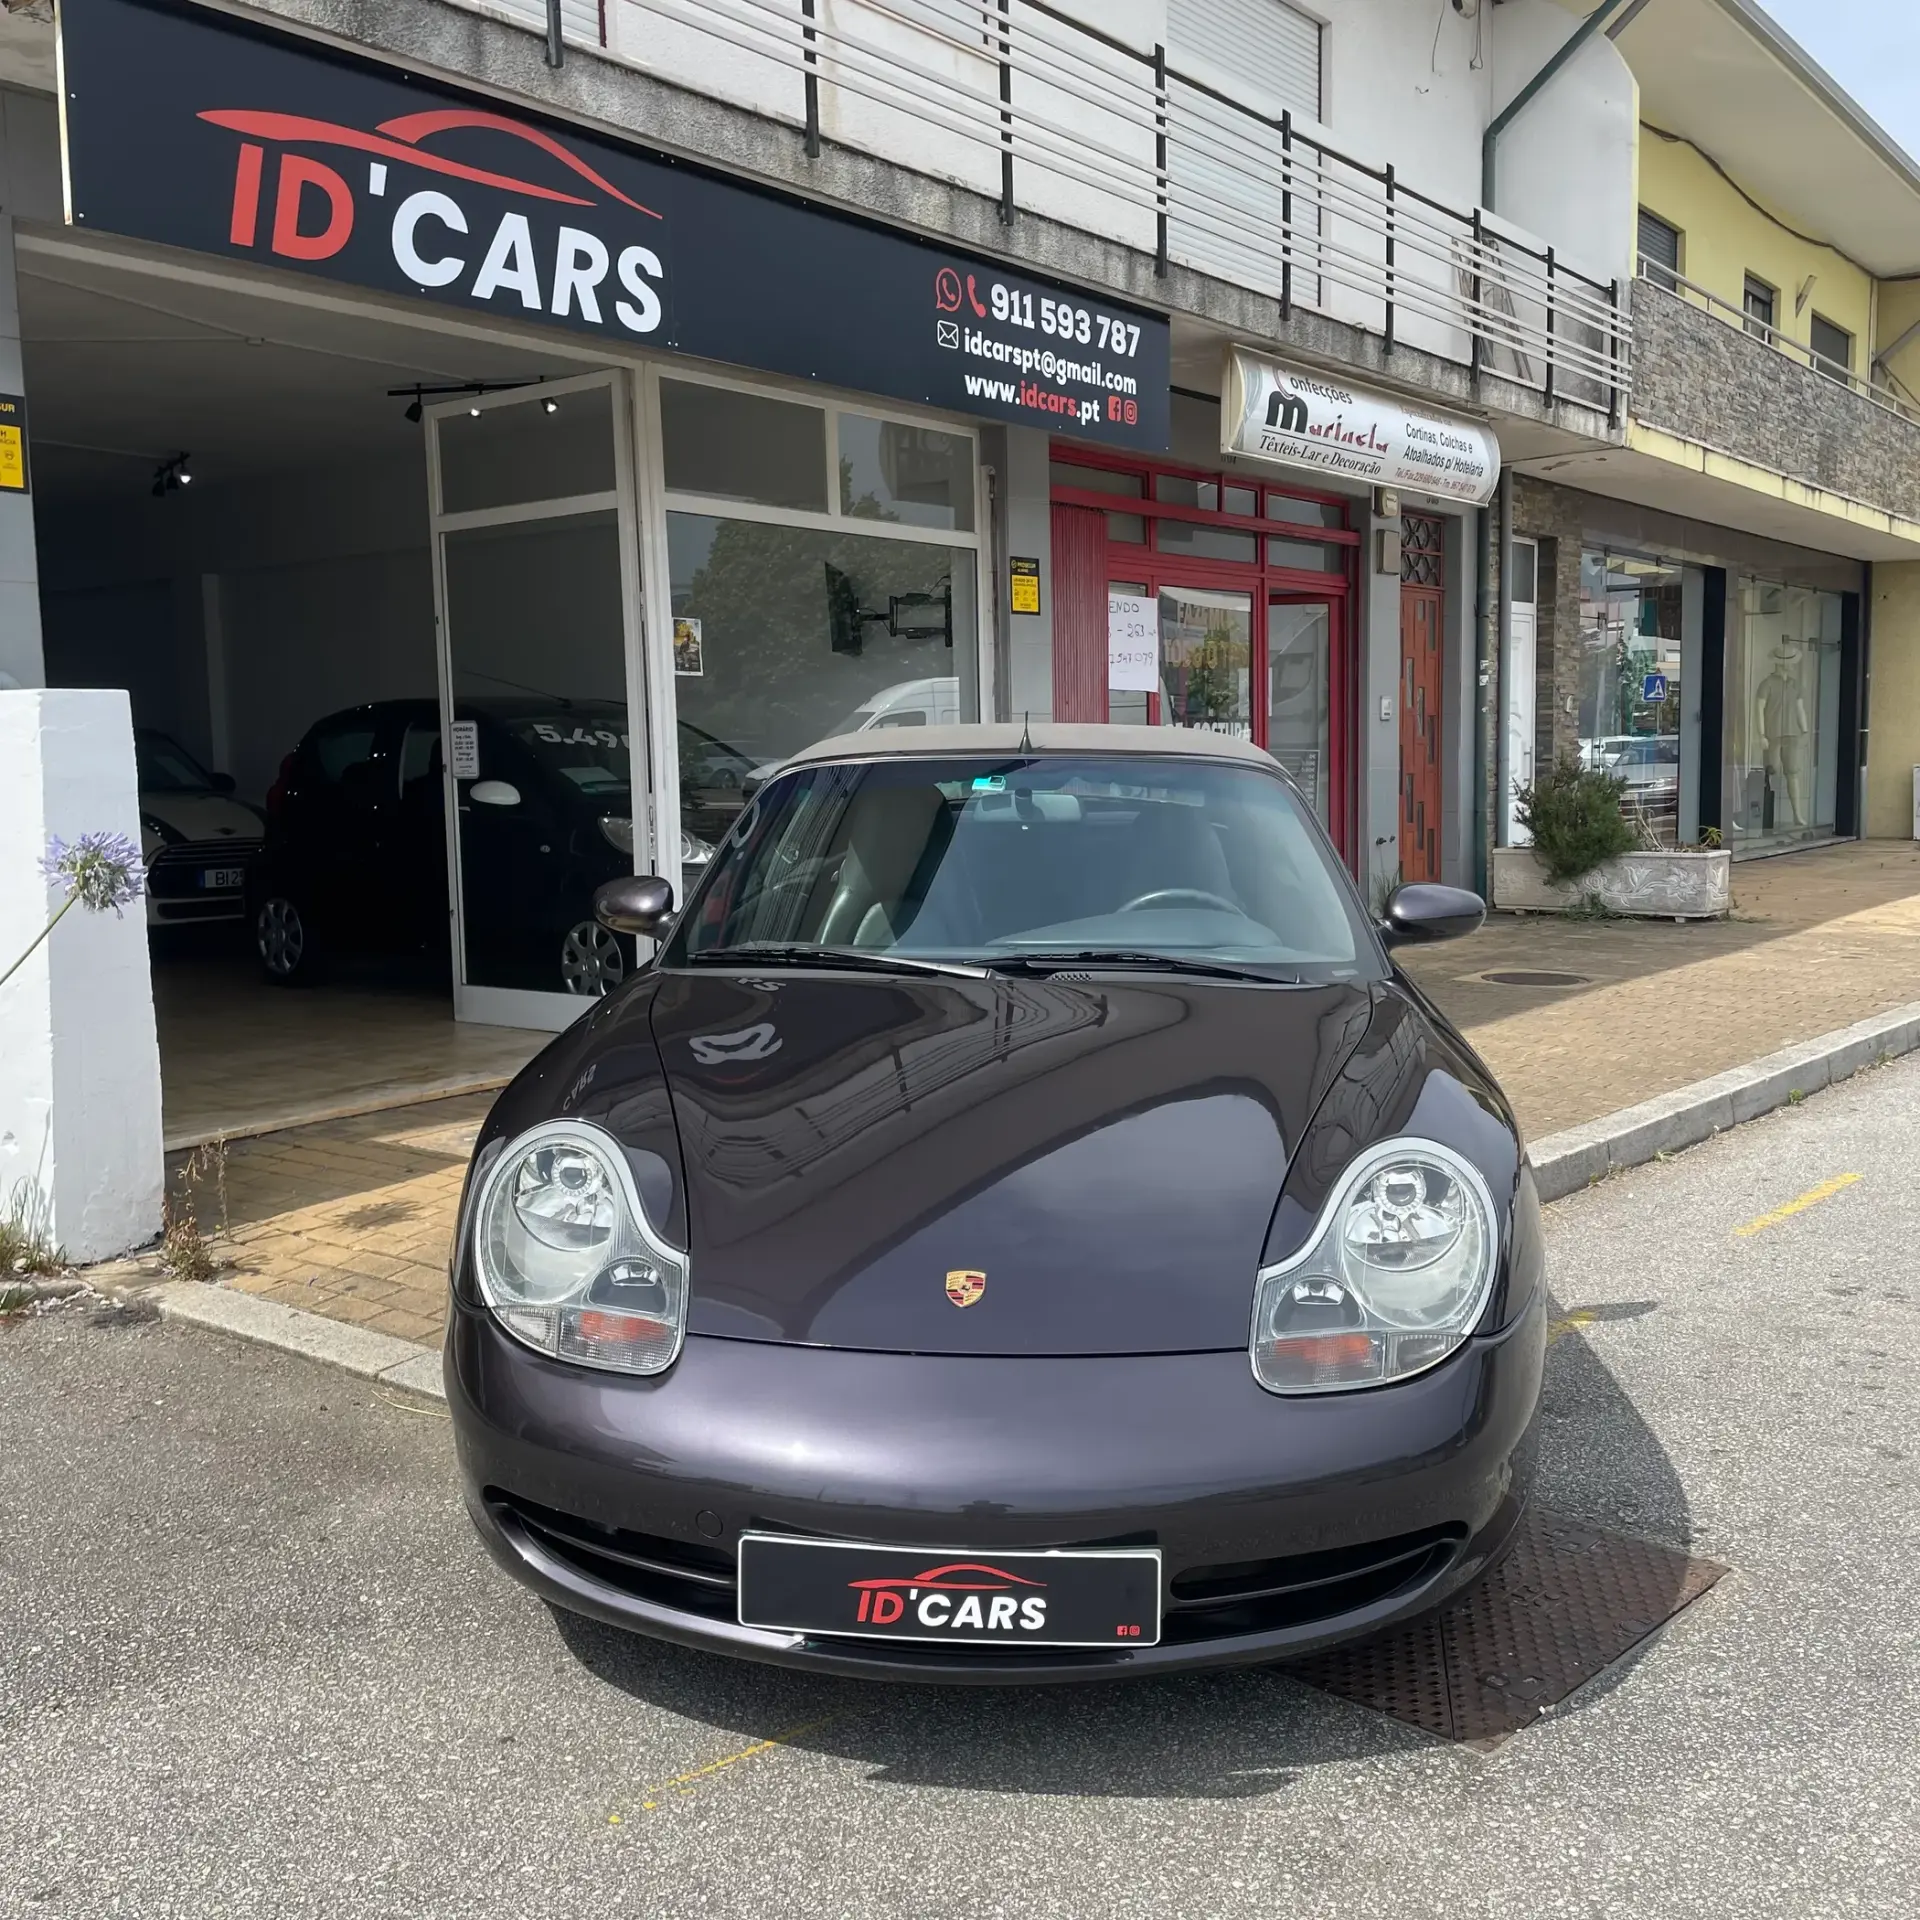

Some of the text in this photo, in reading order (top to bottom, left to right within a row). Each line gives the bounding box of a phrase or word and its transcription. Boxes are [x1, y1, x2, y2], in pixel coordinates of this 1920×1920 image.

[229, 141, 664, 333] ID'CARS
[990, 283, 1141, 358] 911 593 787
[964, 327, 1137, 396] idcarspt@gmail.com
[964, 374, 1100, 426] www.idcars.pt
[1259, 435, 1322, 462] Têxteis-Lar
[1322, 454, 1329, 463] e
[1329, 452, 1382, 476] Decoração
[1406, 423, 1473, 453] Cortinas, Colchas e
[1403, 444, 1484, 477] Atoalhados p/ Hotelaria
[1109, 601, 1140, 613] ENDO
[215, 871, 229, 886] BI
[856, 1588, 1047, 1630] ID'CARS
